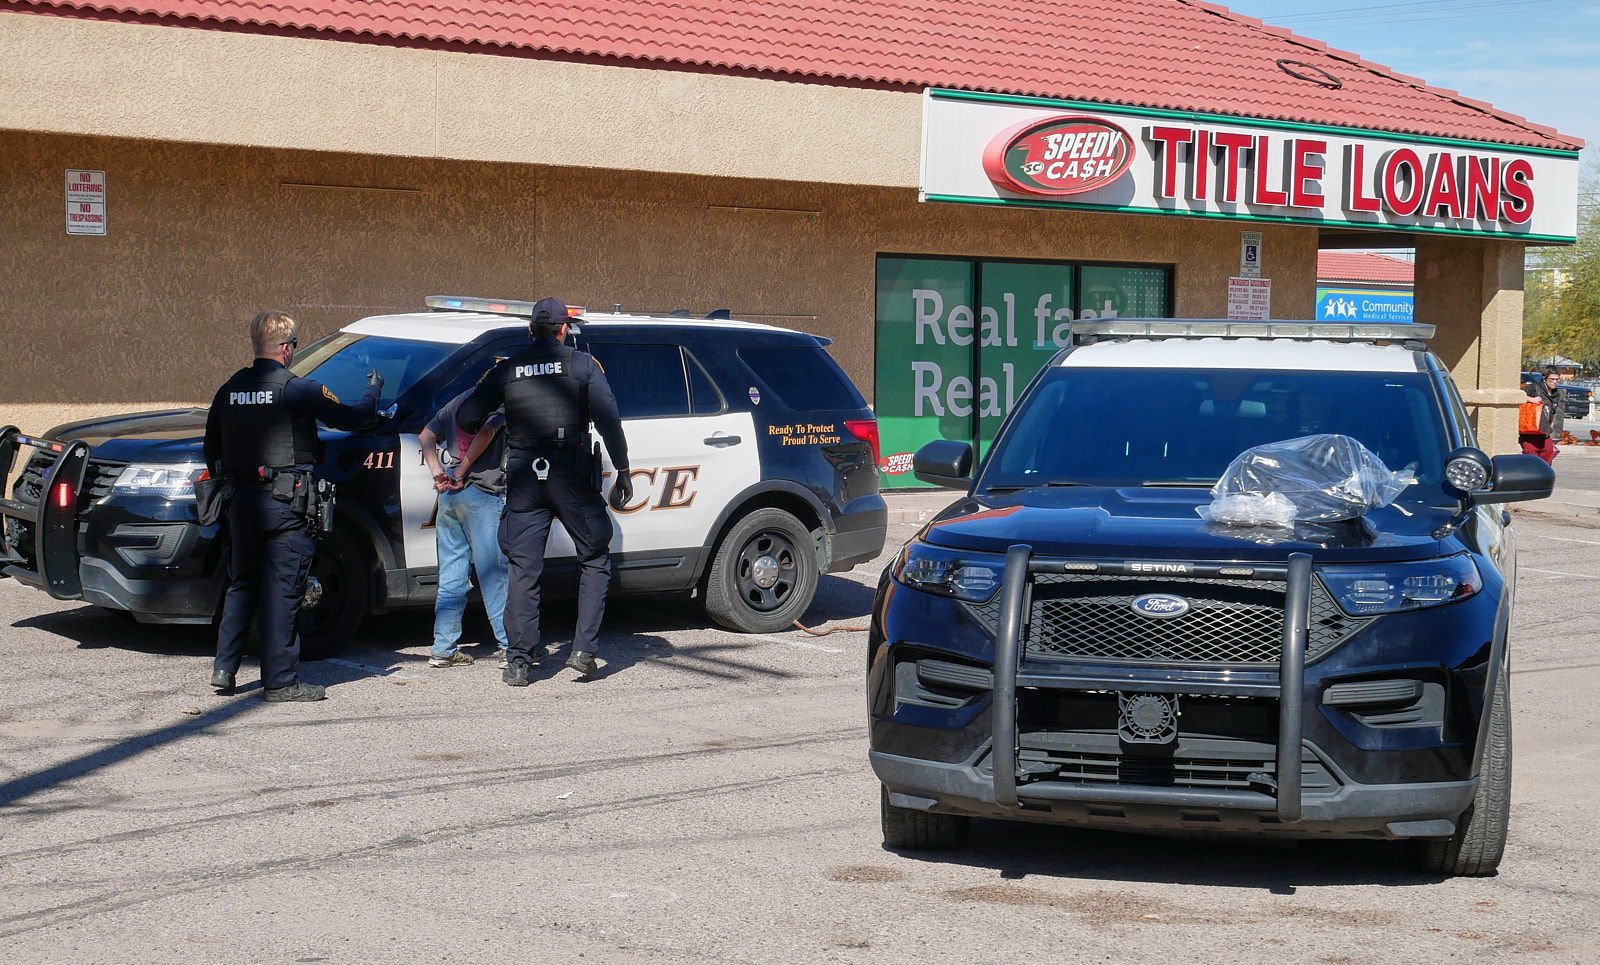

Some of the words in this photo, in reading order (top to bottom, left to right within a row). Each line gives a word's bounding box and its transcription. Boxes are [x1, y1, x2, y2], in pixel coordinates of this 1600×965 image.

[1043, 132, 1122, 160] SPEEDY
[79, 172, 91, 182] NO
[1150, 126, 1327, 208] TITLE
[1350, 143, 1534, 225] LOANS
[68, 183, 102, 192] LOITERING
[79, 203, 91, 213] NO
[69, 213, 103, 223] TRESPASSING
[1362, 300, 1413, 315] Community
[912, 289, 1018, 347] Real
[514, 362, 563, 378] POLICE
[911, 361, 1015, 417] Real
[229, 391, 273, 405] POLICE
[768, 424, 794, 436] Ready
[795, 424, 806, 434] To
[807, 423, 835, 434] Protect
[782, 435, 807, 446] Proud
[808, 435, 819, 445] To
[819, 434, 841, 444] Serve
[363, 452, 394, 469] 411
[1131, 563, 1187, 573] SETINA
[1144, 598, 1184, 612] Ford
